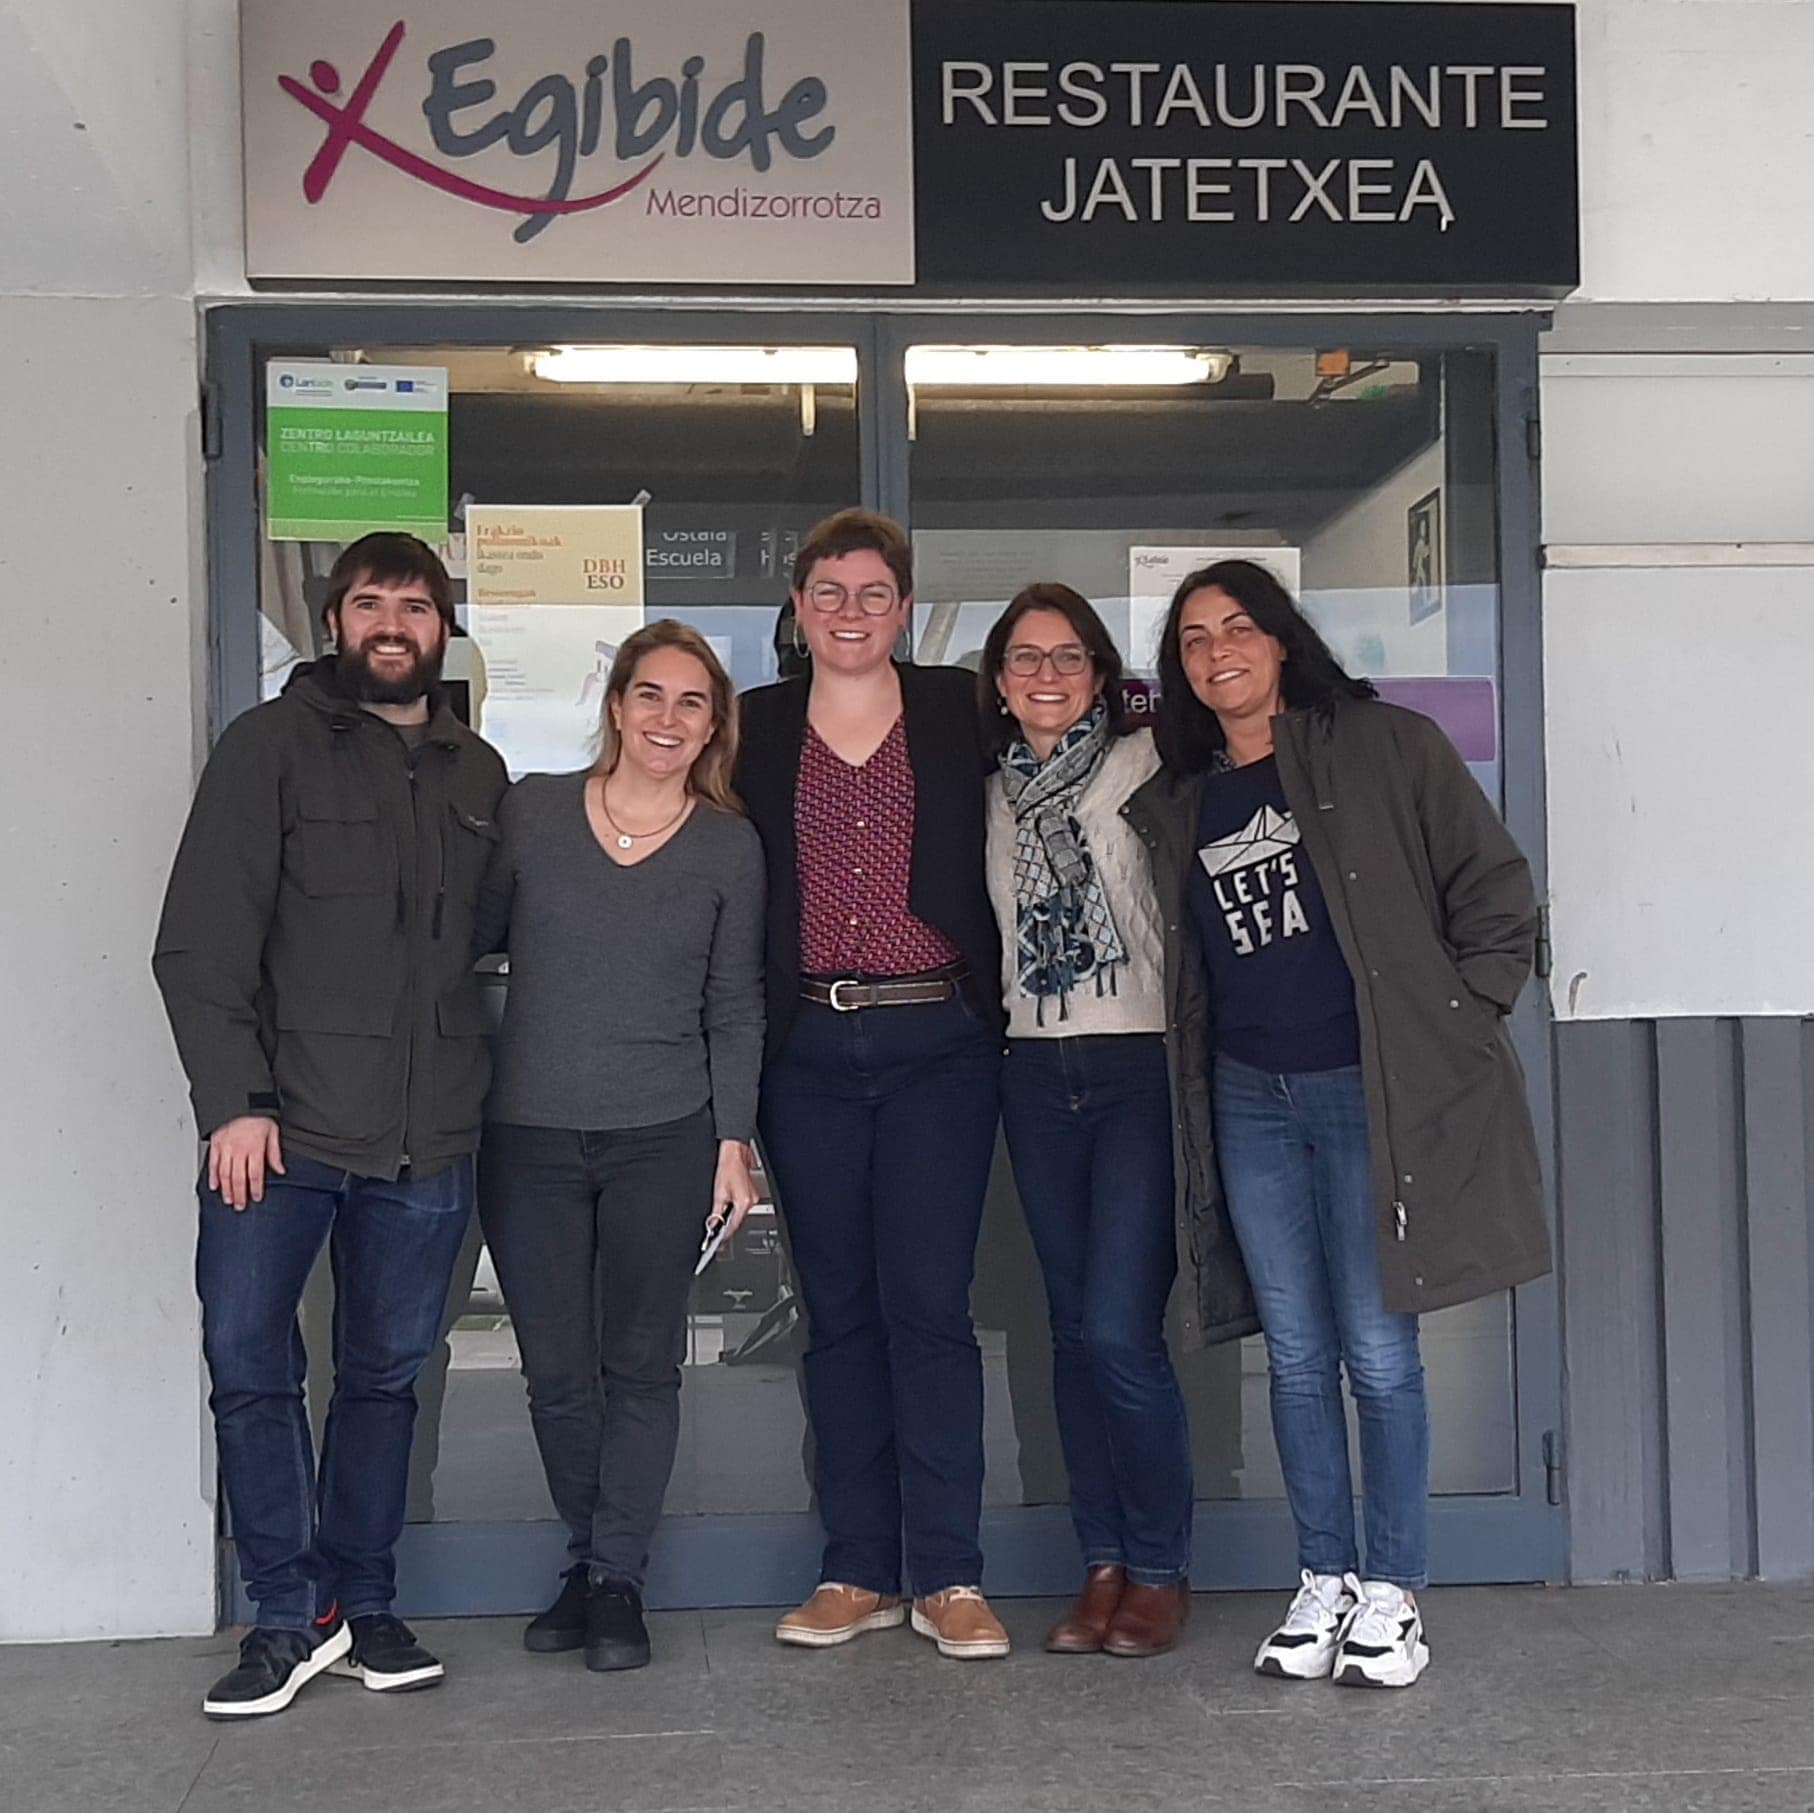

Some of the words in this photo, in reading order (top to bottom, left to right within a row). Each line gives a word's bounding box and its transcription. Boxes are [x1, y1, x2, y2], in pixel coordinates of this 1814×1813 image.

[942, 61, 1548, 130] RESTAURANTE
[423, 32, 835, 243] Egibide
[646, 188, 881, 220] Mendizorrotza
[1040, 157, 1455, 223] JATETXEA
[280, 427, 333, 441] ZENTRO
[583, 558, 626, 574] DBH
[645, 548, 722, 566] Escuela
[587, 574, 625, 590] ESO
[1213, 852, 1299, 911] LET'S
[1225, 889, 1311, 956] SEA
